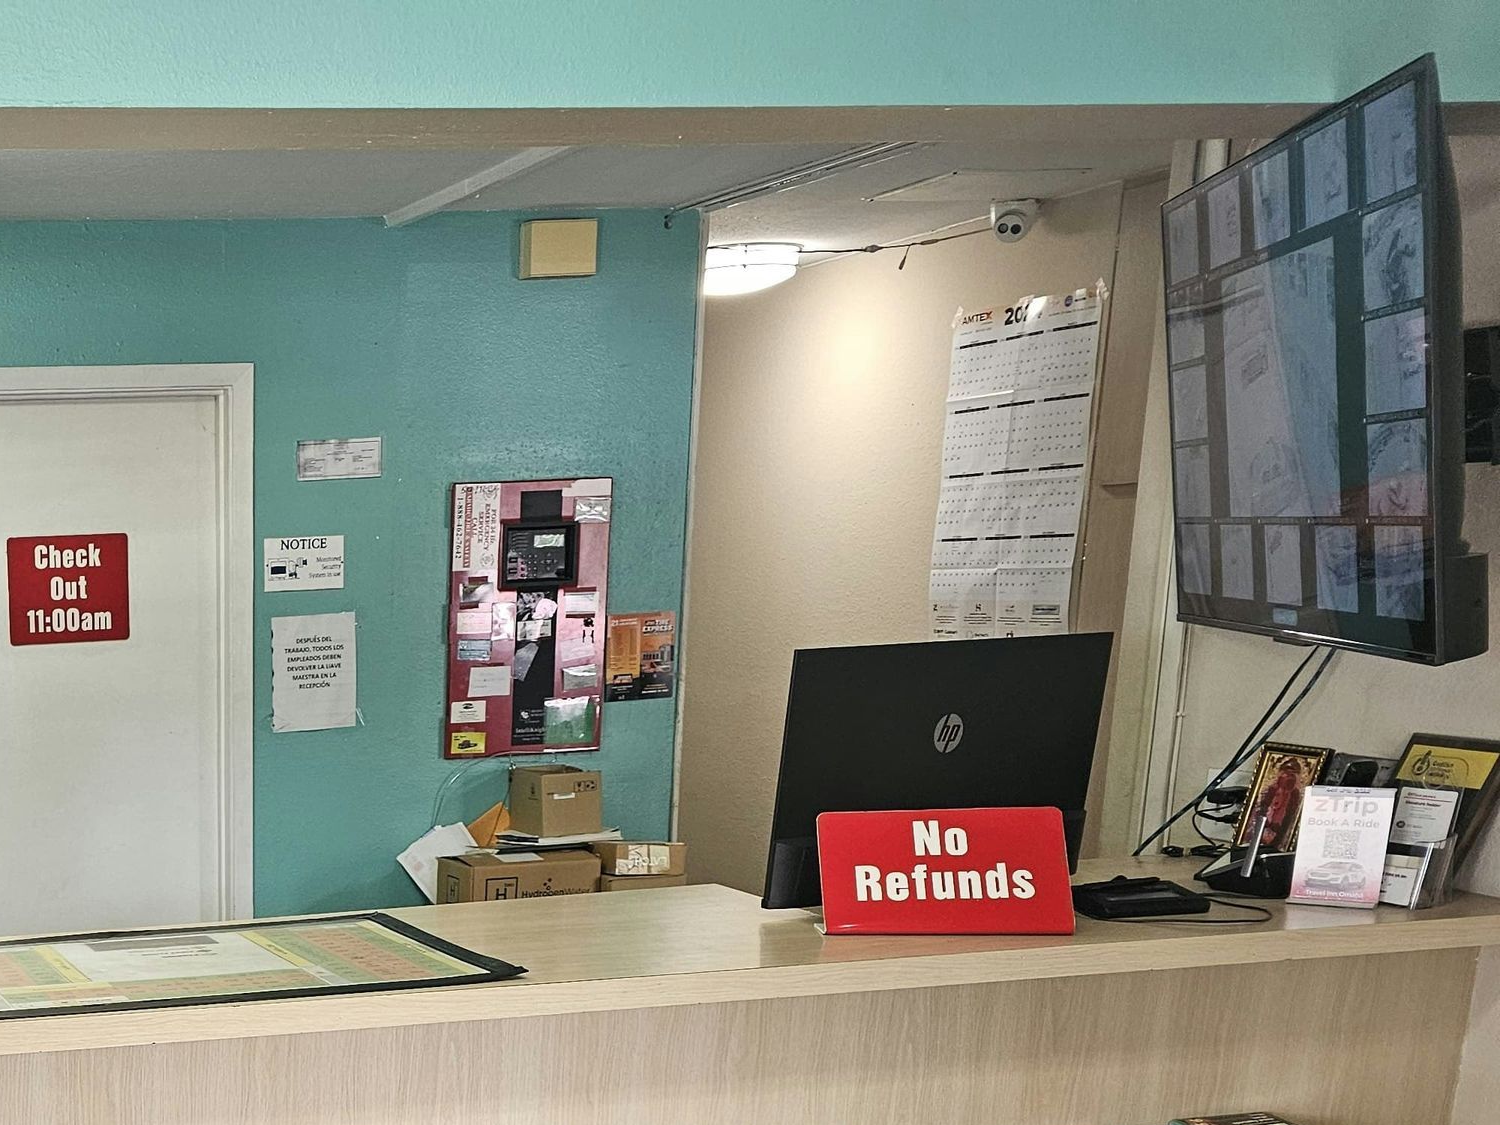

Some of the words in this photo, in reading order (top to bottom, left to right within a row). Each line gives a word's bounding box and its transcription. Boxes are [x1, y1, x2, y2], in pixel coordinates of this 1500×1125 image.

[962, 311, 993, 326] AMTEX
[280, 538, 327, 550] NOTICE
[34, 543, 101, 570] Check
[50, 575, 88, 601] Out
[26, 607, 112, 633] 11:00am
[287, 655, 321, 663] EMPLEADOS
[322, 653, 341, 661] DEBEN
[287, 664, 316, 672] DEVOLVER
[292, 673, 319, 681] MAESTRA
[934, 714, 963, 753] hp
[1314, 797, 1379, 817] zTrip
[1308, 817, 1338, 826] Book
[1354, 819, 1380, 828] Ride
[912, 820, 968, 856] No
[854, 862, 1036, 901] Refunds
